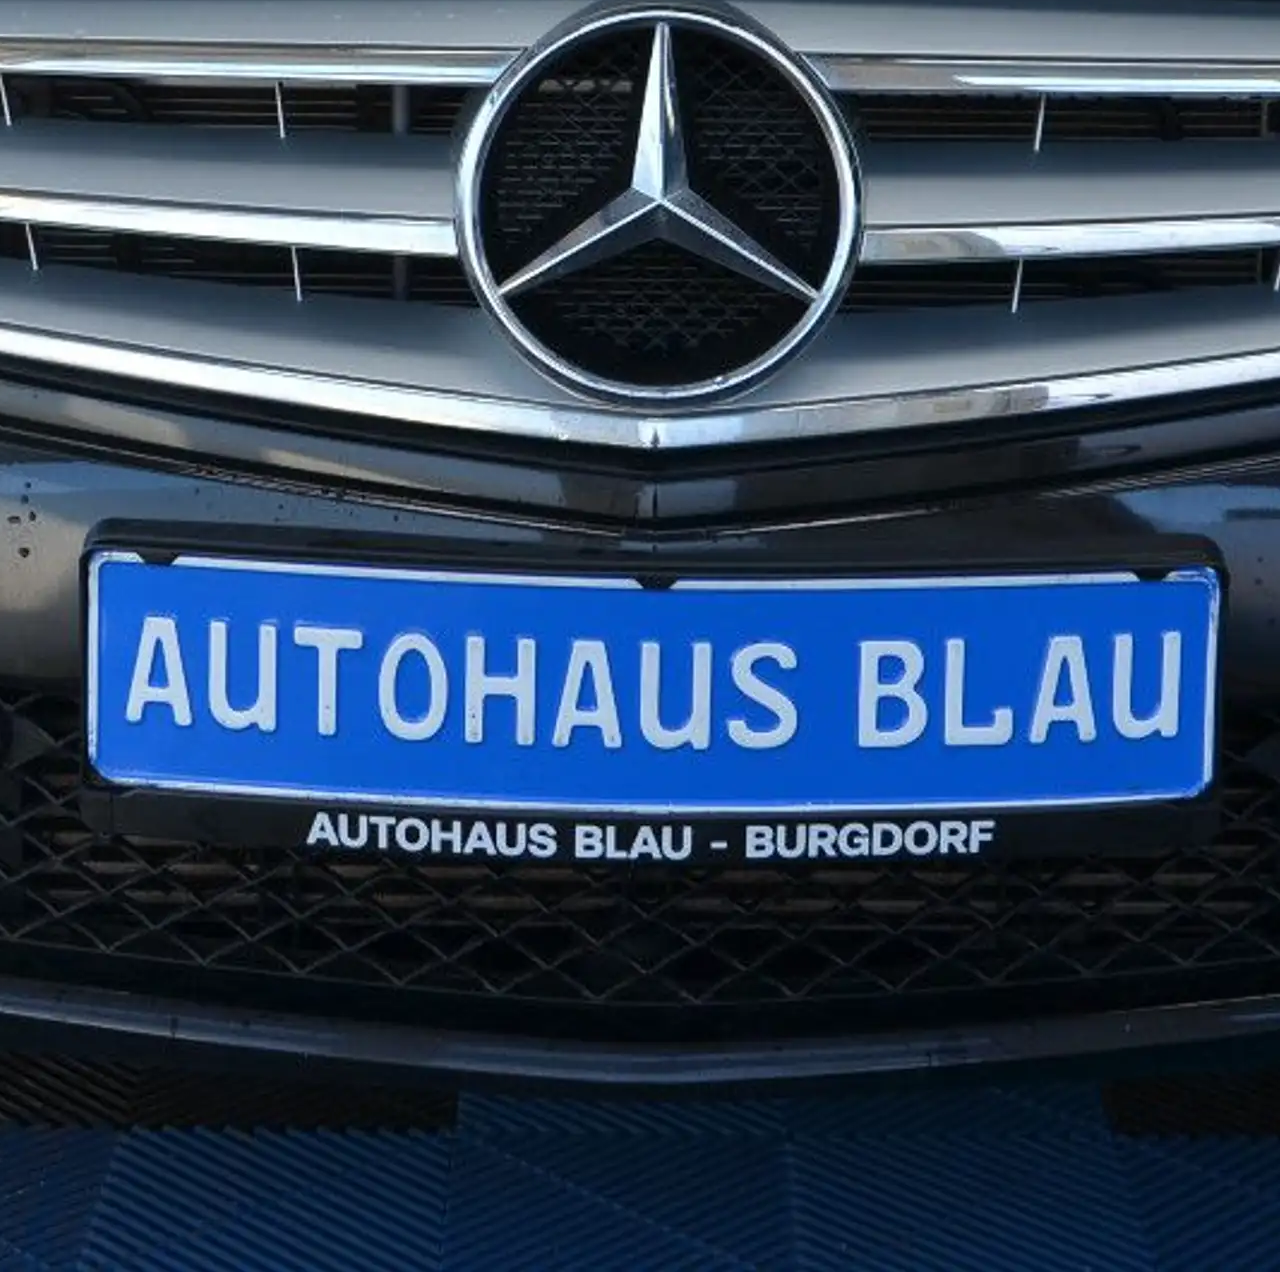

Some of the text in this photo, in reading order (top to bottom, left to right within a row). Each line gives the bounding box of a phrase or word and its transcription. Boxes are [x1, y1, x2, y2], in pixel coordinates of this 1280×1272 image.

[125, 616, 1181, 750] AUTOHAUS BLAU
[307, 811, 557, 858] AUTOHAUS
[574, 825, 693, 859] BLAU
[745, 819, 995, 858] BURGDORF
